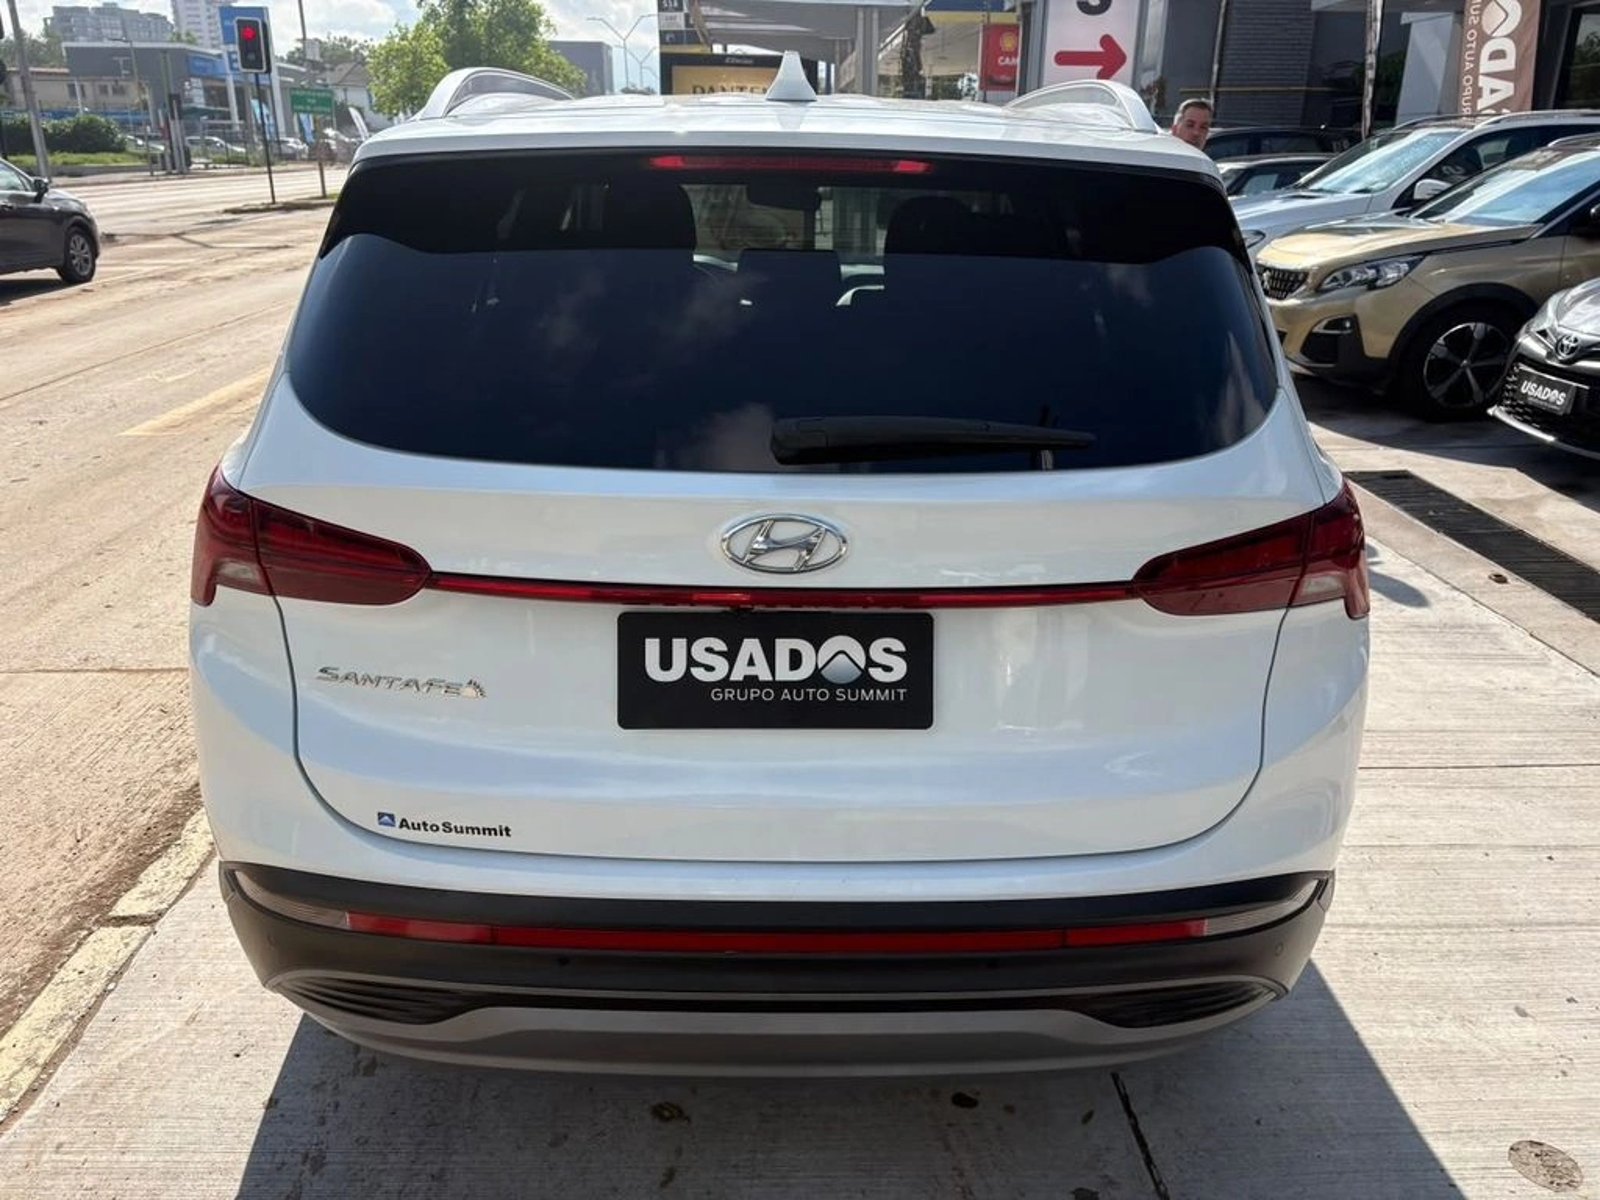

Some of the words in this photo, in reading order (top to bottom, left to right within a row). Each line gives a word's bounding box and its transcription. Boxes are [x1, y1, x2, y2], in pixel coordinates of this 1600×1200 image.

[1521, 380, 1567, 405] USADOS
[644, 635, 908, 684] USADOS
[711, 688, 774, 701] GRUPO
[780, 688, 829, 701] AUTO
[835, 688, 907, 701] SUMMIT
